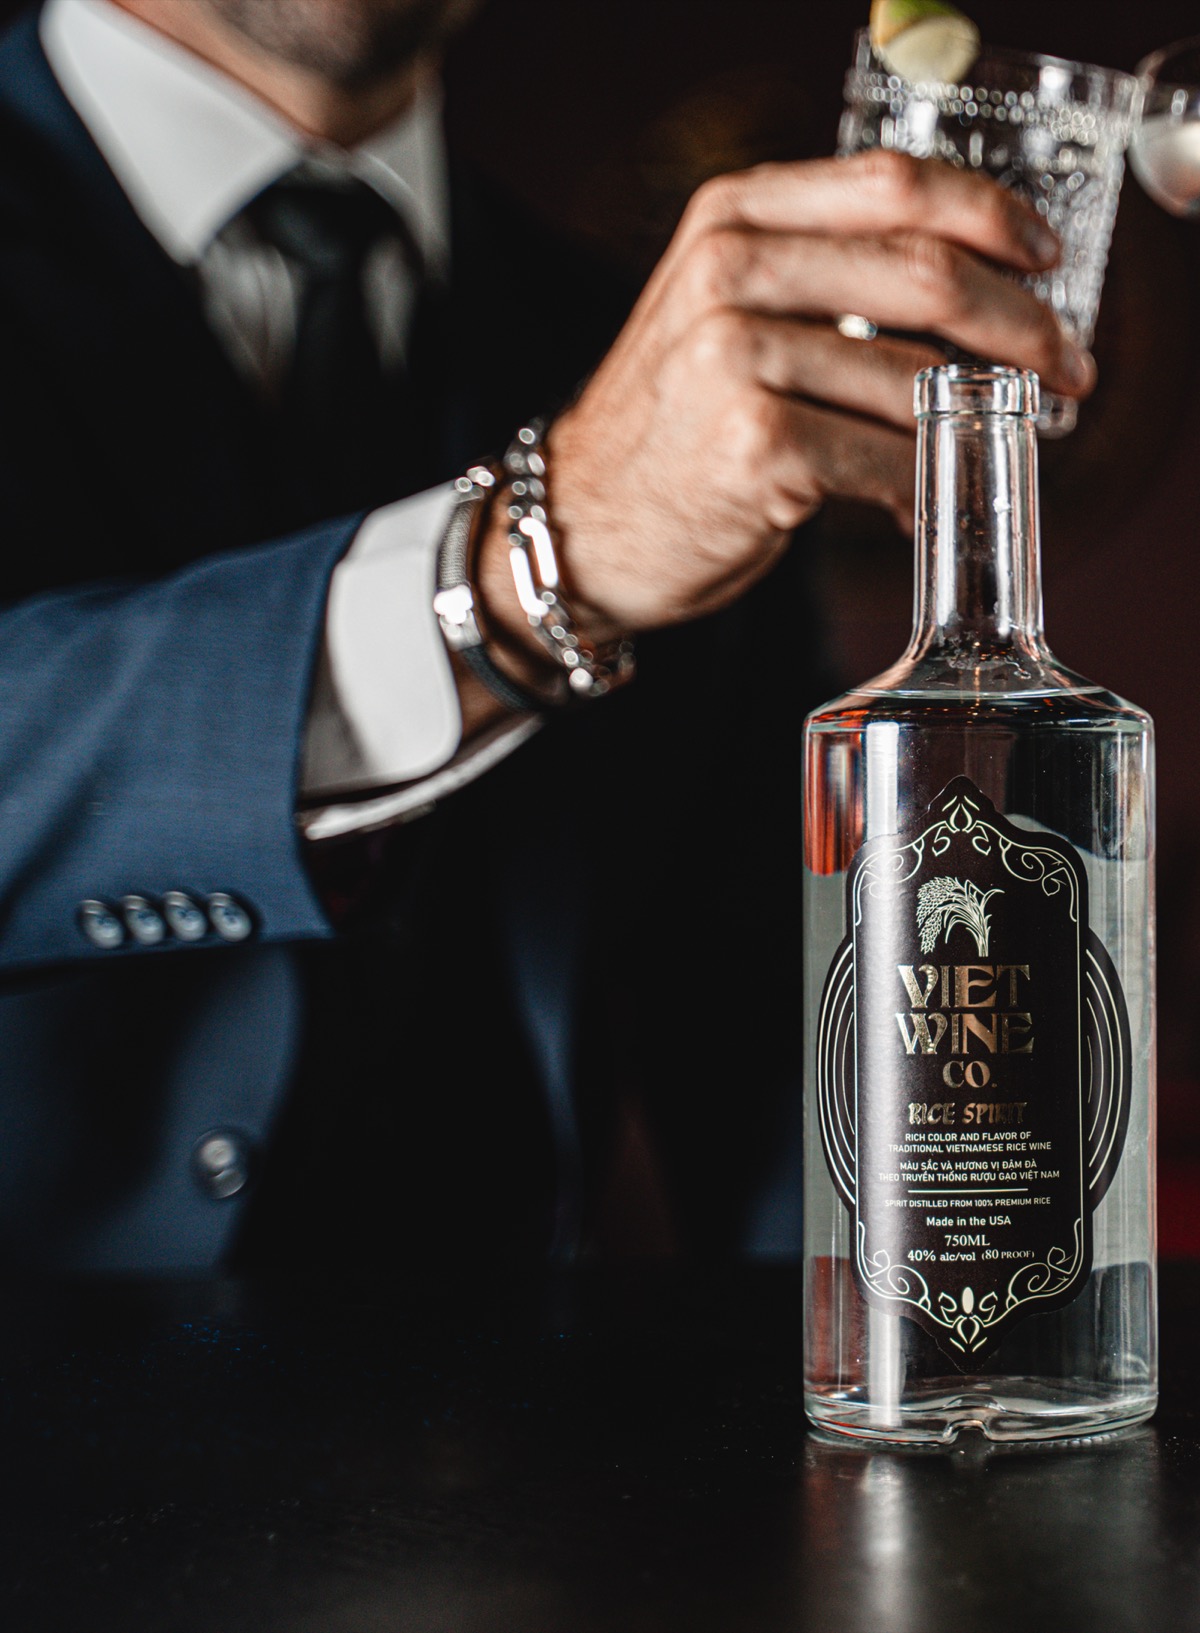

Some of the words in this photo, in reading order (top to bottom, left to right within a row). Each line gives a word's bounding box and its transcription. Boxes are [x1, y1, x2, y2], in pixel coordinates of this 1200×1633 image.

[897, 964, 1031, 1009] VIET
[895, 1012, 1035, 1055] WINE
[942, 1060, 998, 1089] CO.
[908, 1102, 956, 1125] RICE
[962, 1102, 1027, 1125] SPIRIT
[905, 1133, 926, 1142] RICH
[927, 1132, 958, 1142] COLOR
[959, 1132, 980, 1141] AND
[982, 1131, 1018, 1141] FLAVOR
[1019, 1131, 1032, 1140] OF
[888, 1144, 944, 1153] TRADITIONAL
[945, 1143, 1004, 1153] VIETNAMESE
[1006, 1142, 1027, 1151] RICE
[1028, 1141, 1052, 1151] WINE
[900, 1160, 919, 1170] MÀU
[940, 1160, 953, 1170] VÀ
[879, 1172, 900, 1182] THEO
[1040, 1170, 1060, 1179] NAM
[909, 1200, 948, 1208] DISTILLED
[950, 1200, 973, 1208] FROM
[974, 1199, 993, 1207] 100%
[995, 1198, 1032, 1206] PREMIUM
[1033, 1197, 1051, 1205] RICE
[926, 1217, 954, 1227] Made
[956, 1216, 967, 1226] in
[969, 1216, 986, 1226] the
[989, 1215, 1012, 1226] USA
[944, 1234, 991, 1247] 750ML
[907, 1250, 936, 1262] 40%
[939, 1251, 976, 1262] alc/vol
[981, 1249, 999, 1261] (80
[1001, 1250, 1035, 1260] PROOF)
